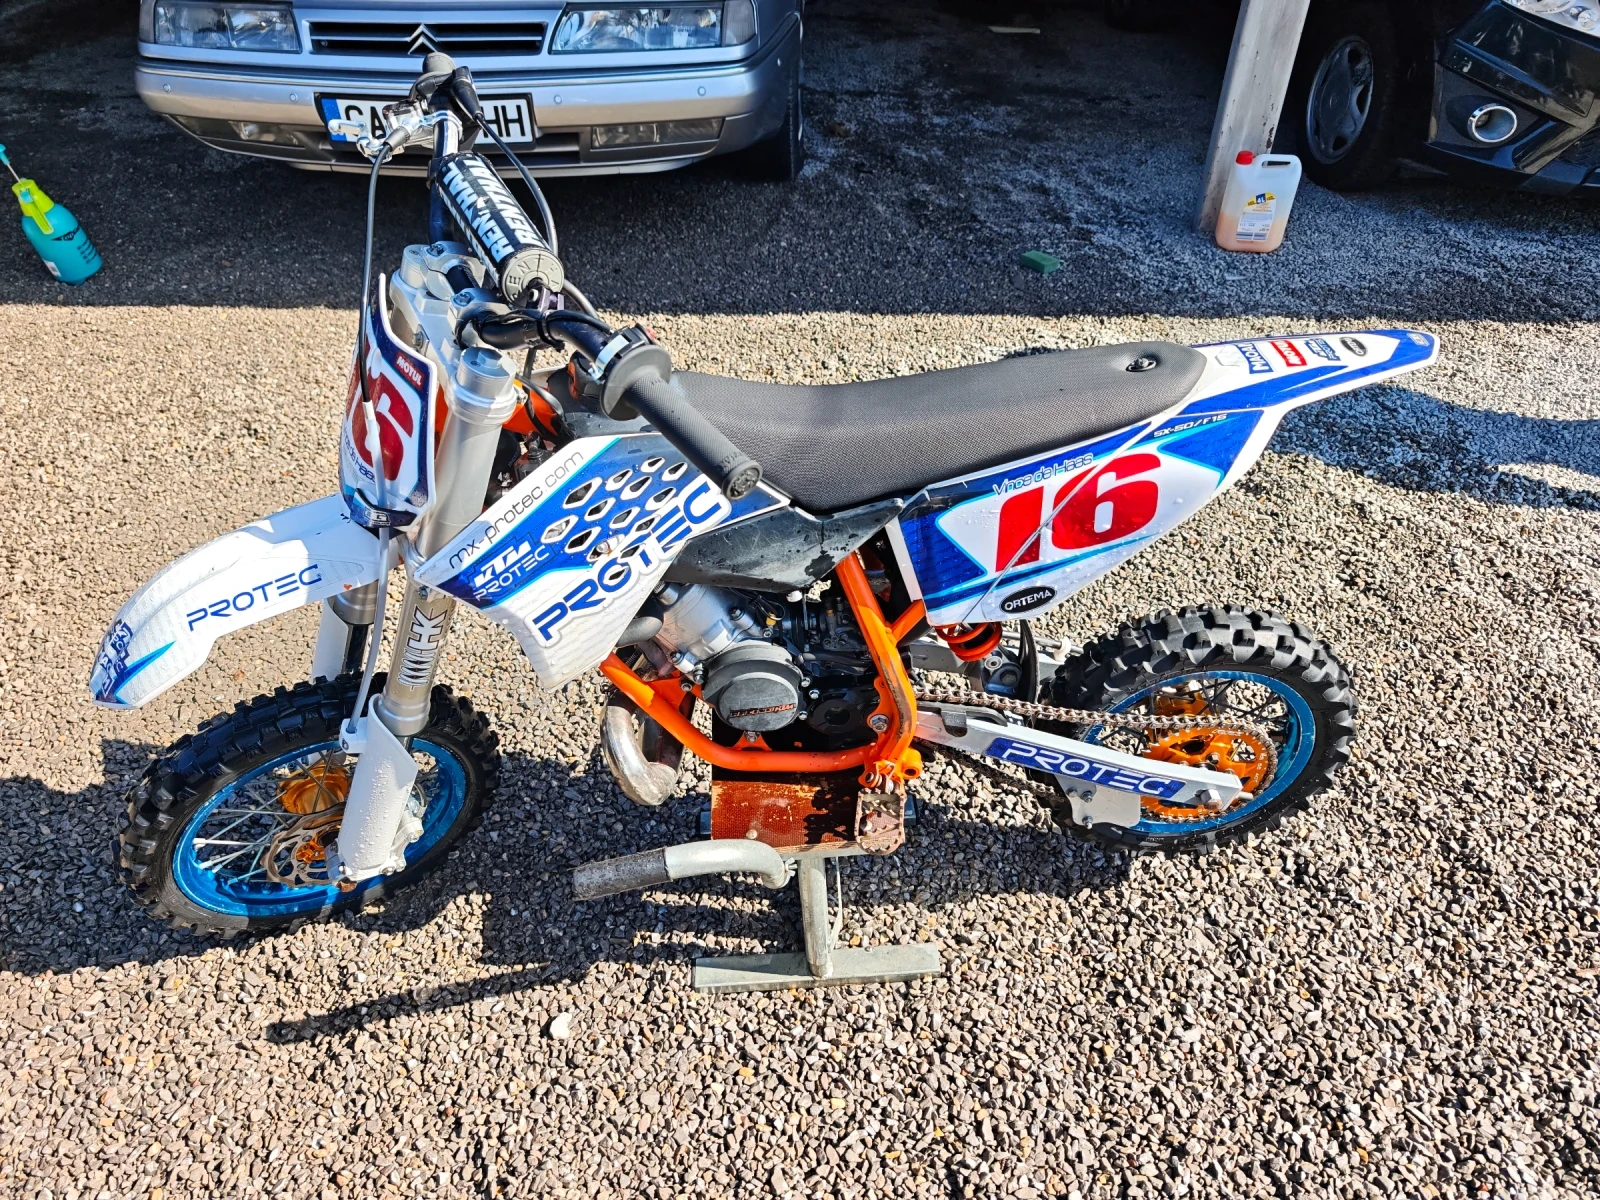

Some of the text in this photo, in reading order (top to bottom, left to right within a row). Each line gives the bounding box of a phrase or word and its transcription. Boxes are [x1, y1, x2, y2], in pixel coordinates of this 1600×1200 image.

[397, 356, 422, 385] MOTUL
[1153, 413, 1227, 438] SX-50/F15
[992, 453, 1094, 496] Vince de Haas
[449, 451, 584, 569] mx-protec.com
[995, 453, 1161, 572] 16
[473, 540, 531, 587] KTM
[473, 544, 550, 601] PROTEC
[532, 482, 722, 641] PROTEC
[186, 563, 322, 632] PROTEC
[1003, 588, 1053, 611] ORTEMA
[1001, 742, 1172, 795] PROTEC
